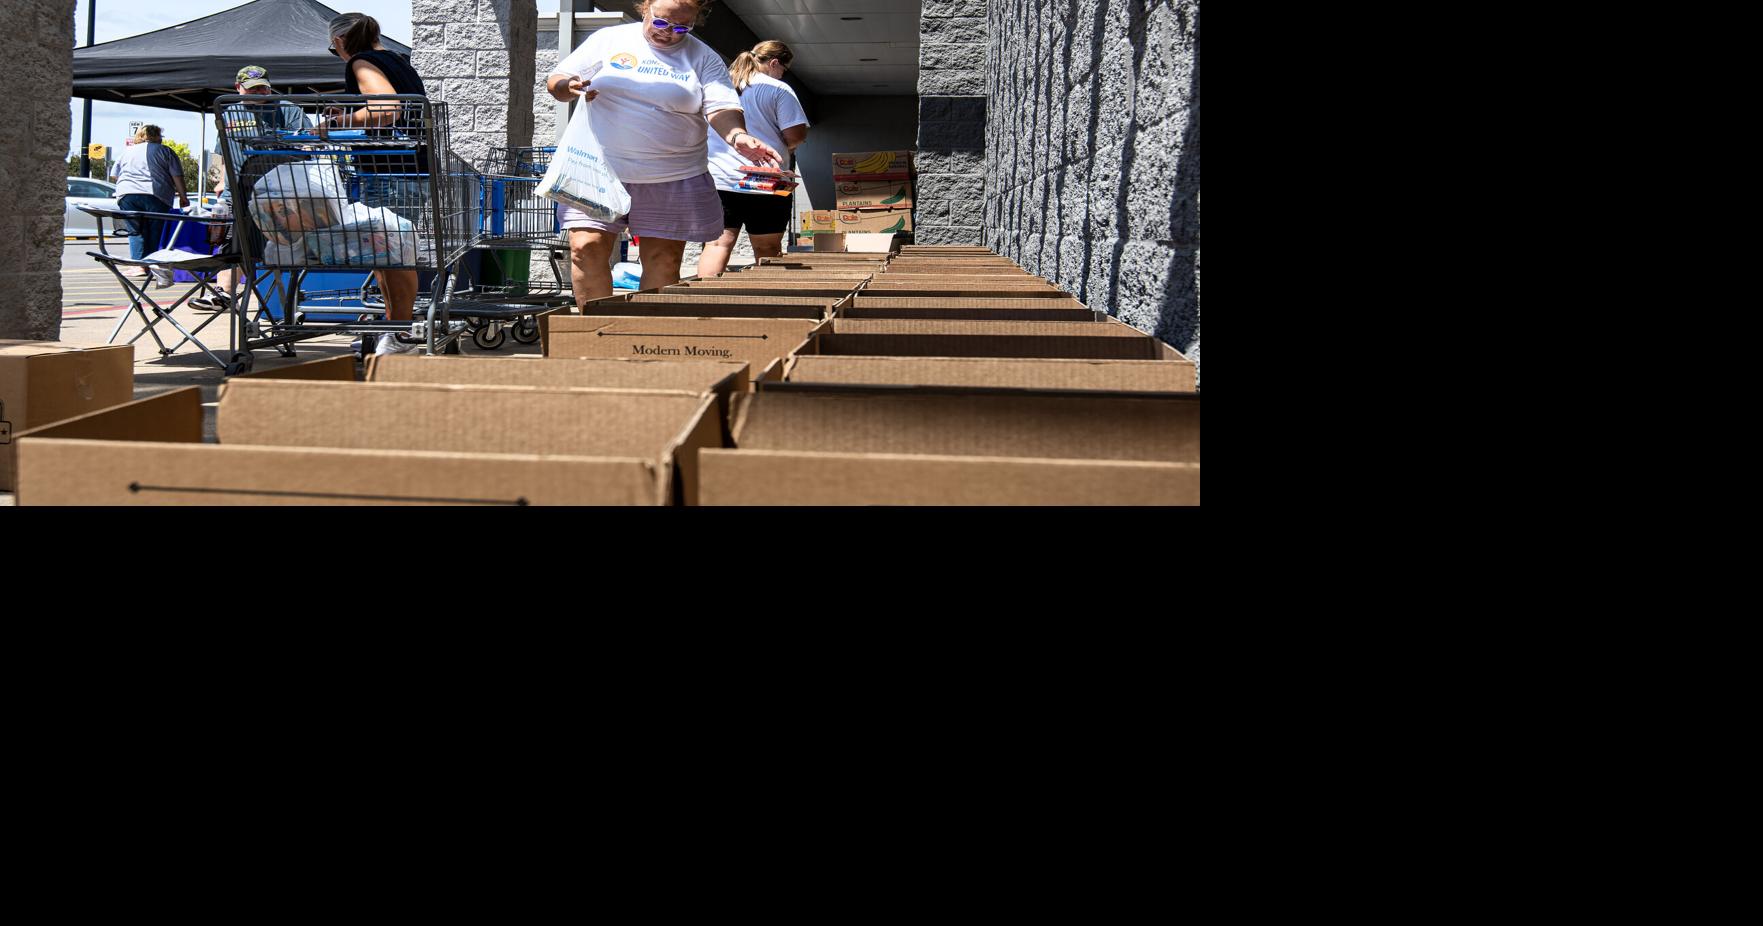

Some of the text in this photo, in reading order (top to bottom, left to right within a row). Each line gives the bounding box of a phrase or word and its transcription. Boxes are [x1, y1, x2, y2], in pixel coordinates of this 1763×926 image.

[637, 66, 691, 82] UNITED WAY
[632, 344, 733, 358] Modern Moving.
